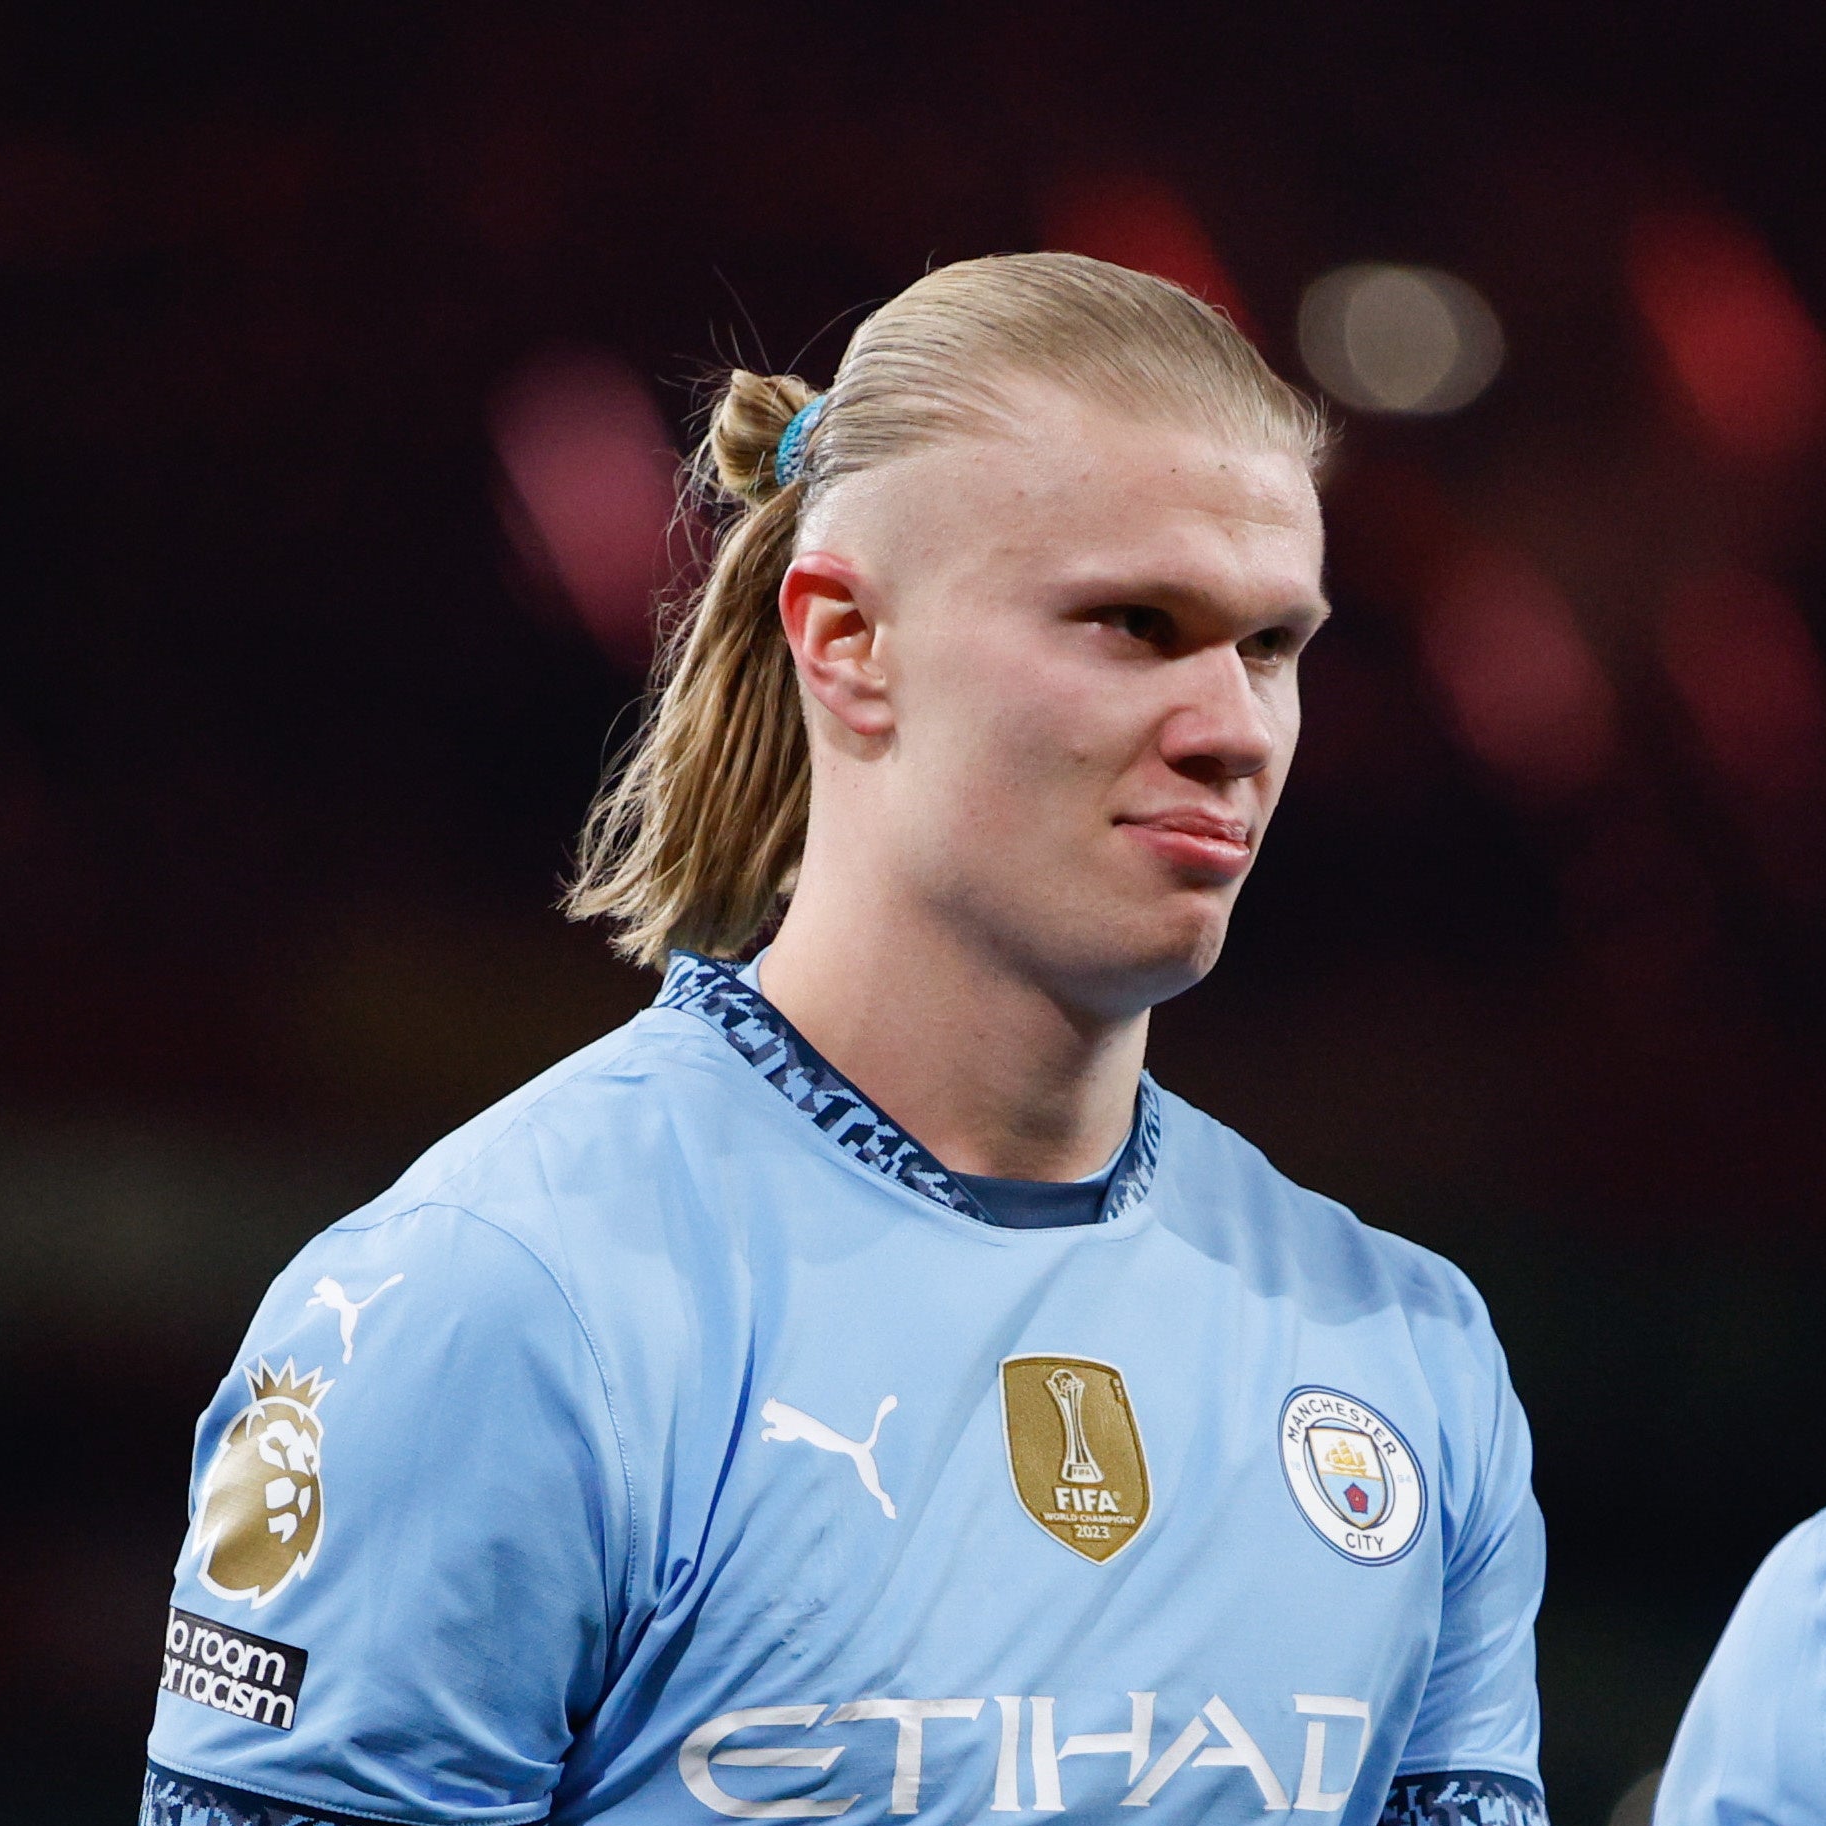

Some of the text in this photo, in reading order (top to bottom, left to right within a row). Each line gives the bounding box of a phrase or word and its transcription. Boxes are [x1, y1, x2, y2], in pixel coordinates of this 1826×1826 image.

[1288, 1398, 1398, 1456] MANCHESTER
[1042, 1512, 1136, 1525] WORLD CHAMPIONS
[1055, 1487, 1119, 1513] FIFA
[1073, 1523, 1111, 1539] 2023
[1345, 1532, 1384, 1552] CITY
[189, 1626, 286, 1687] room
[159, 1653, 295, 1730] or racism
[678, 1691, 1370, 1818] ETIHAD
